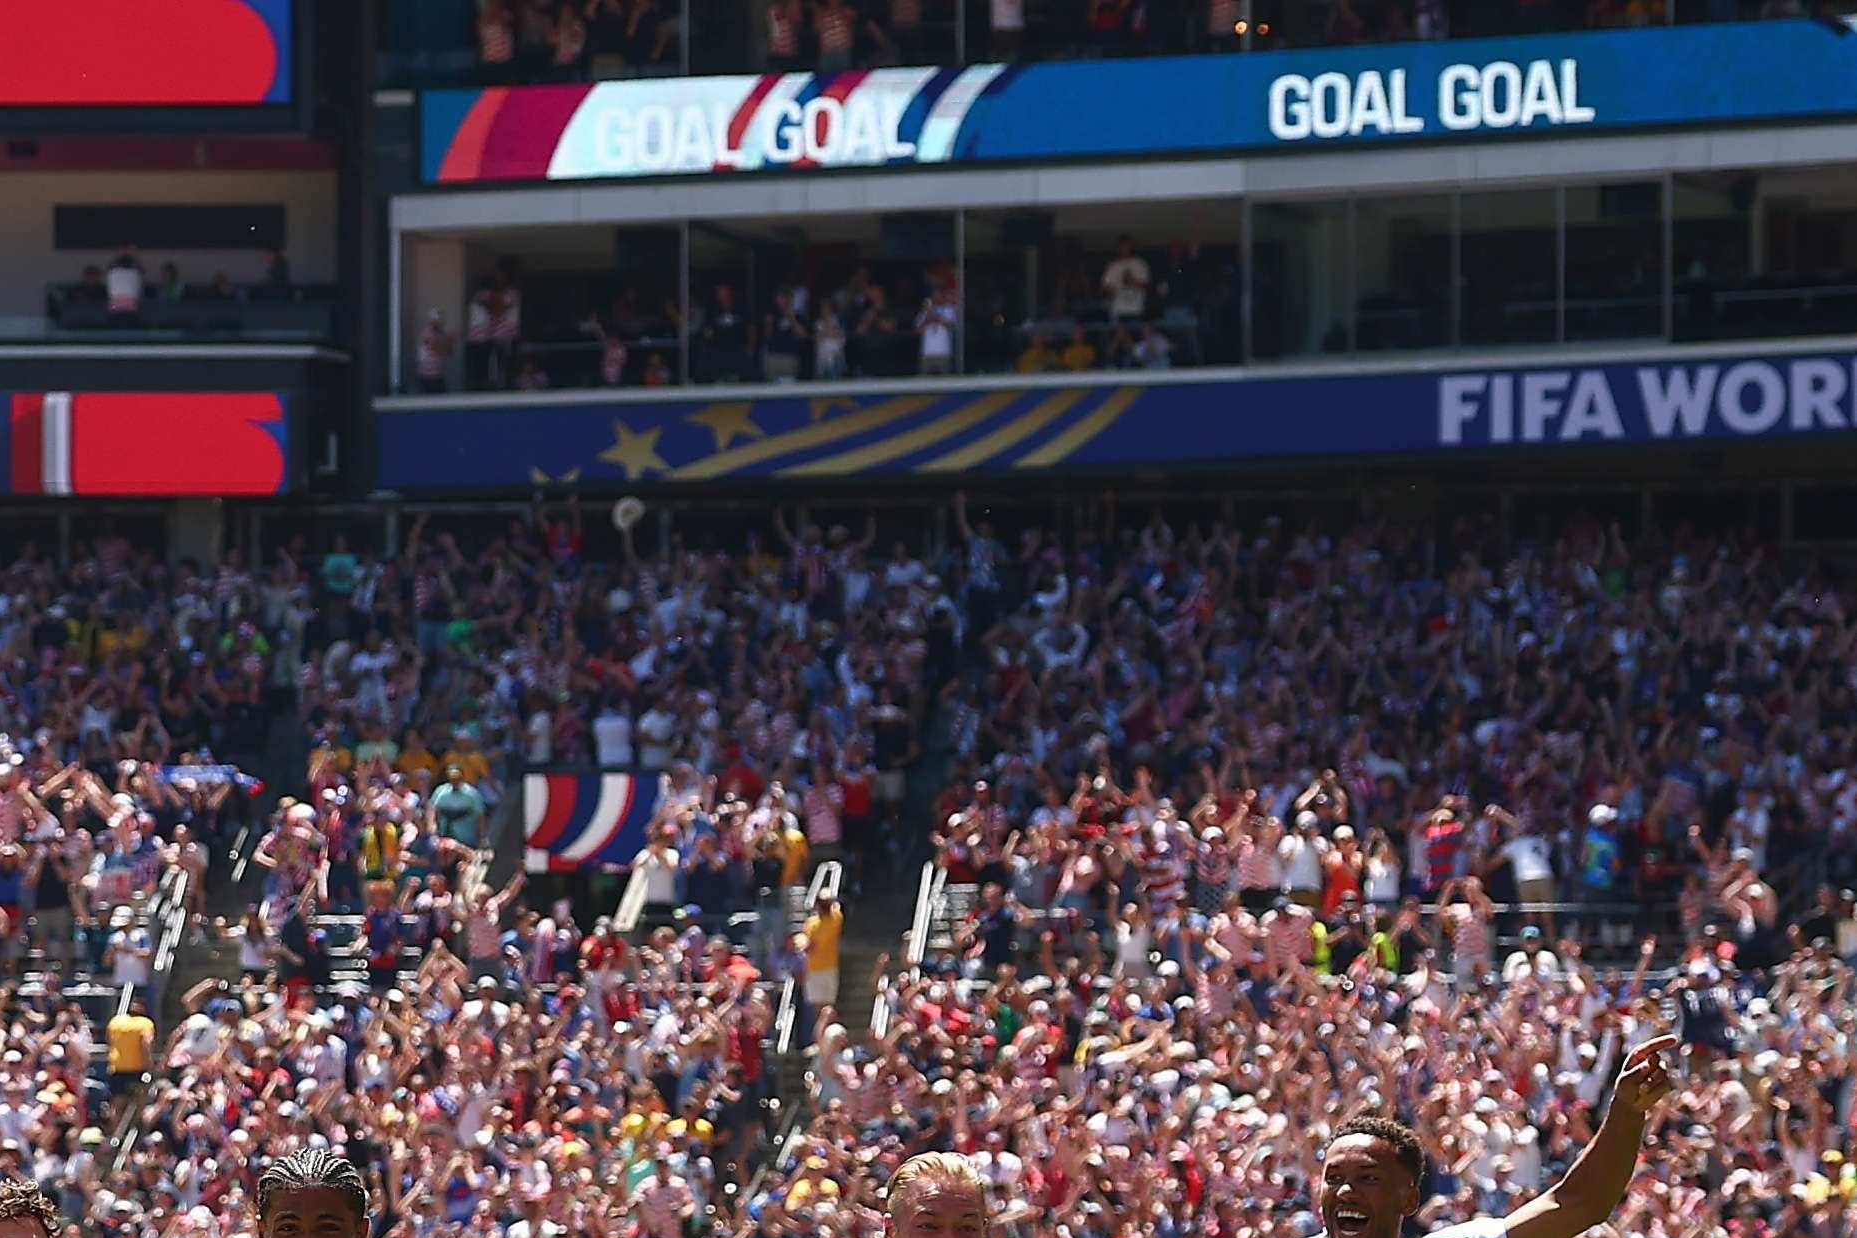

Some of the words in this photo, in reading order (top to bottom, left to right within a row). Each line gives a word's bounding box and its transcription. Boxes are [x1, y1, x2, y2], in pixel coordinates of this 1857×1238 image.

[594, 106, 744, 168] GOAL
[765, 96, 917, 165] GOAL
[1269, 69, 1425, 140] GOAL
[1438, 58, 1596, 130] GOAL
[1438, 370, 1626, 444] FIFA
[1636, 356, 1857, 436] WOR
